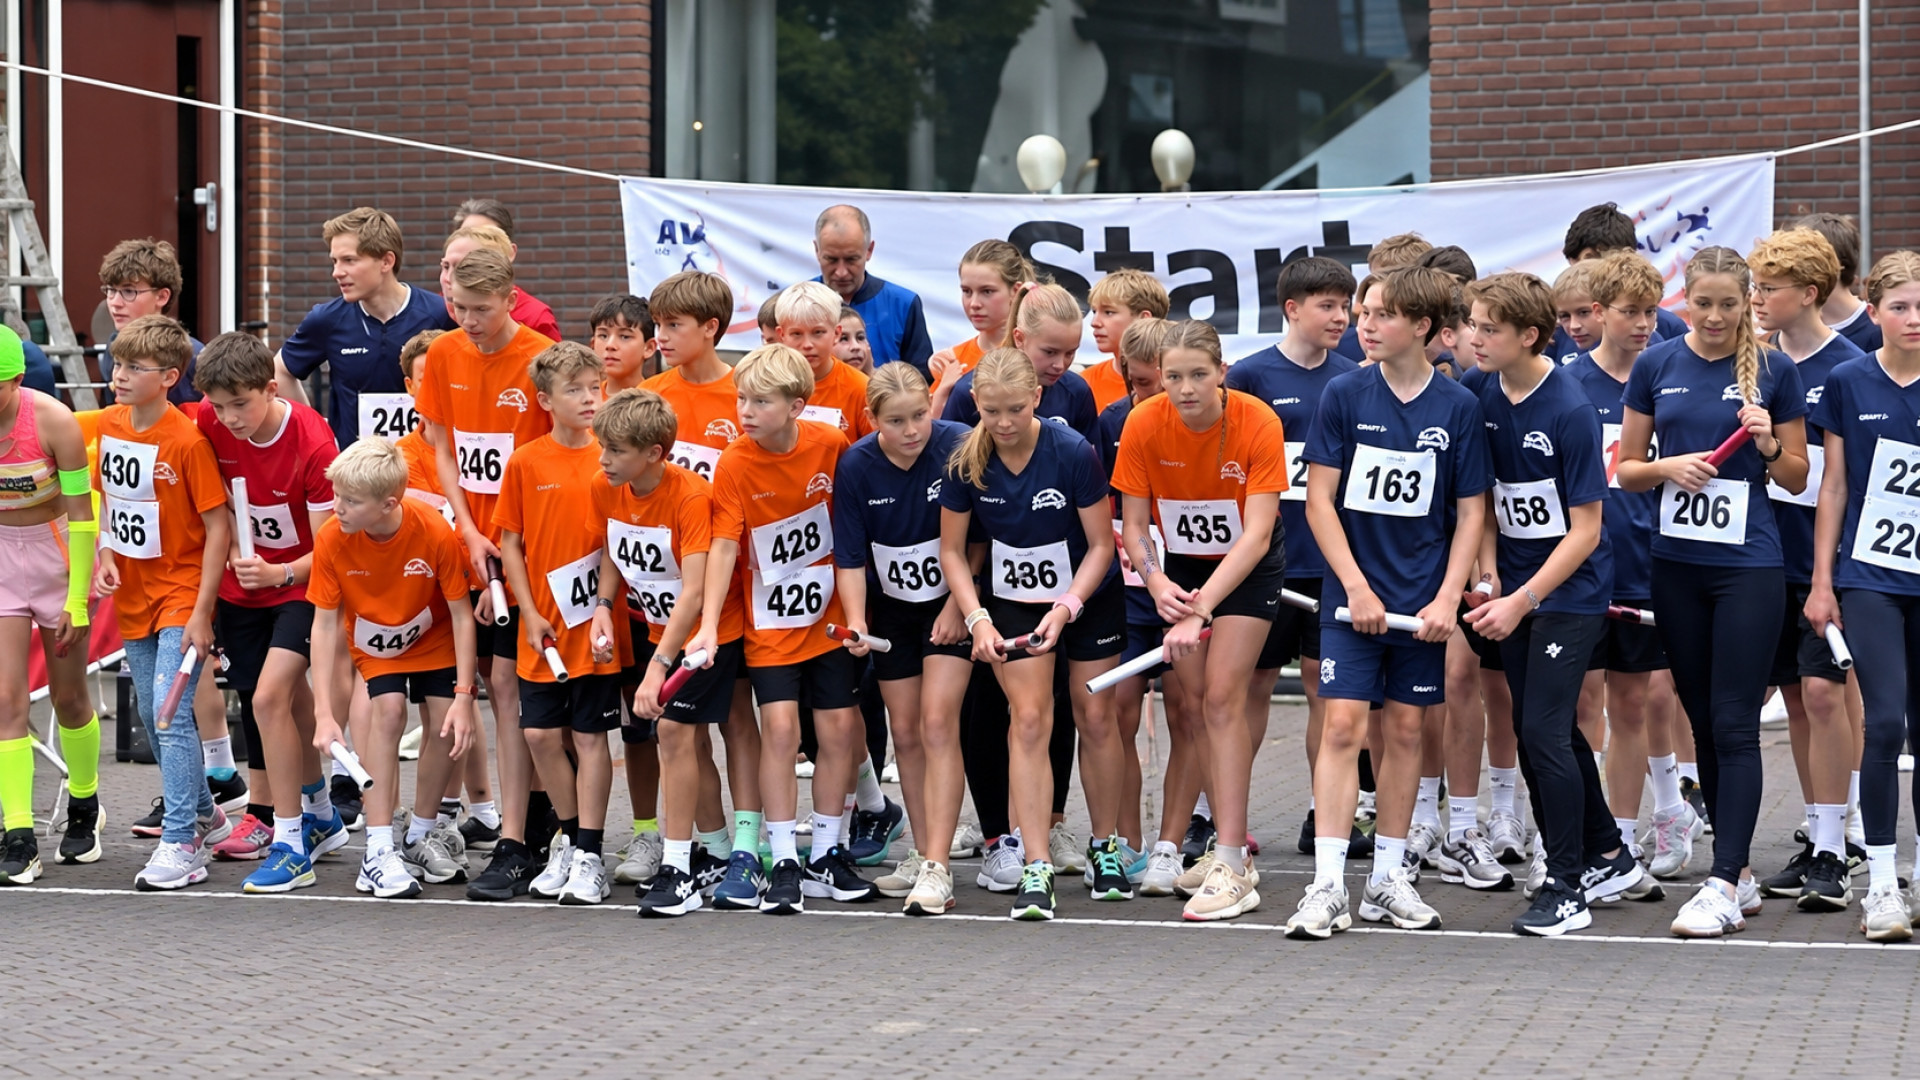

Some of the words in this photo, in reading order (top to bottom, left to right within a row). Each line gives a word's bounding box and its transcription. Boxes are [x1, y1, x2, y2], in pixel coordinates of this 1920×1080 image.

[372, 407, 419, 437] 246
[101, 452, 140, 489] 430
[459, 446, 502, 482] 246
[1291, 456, 1308, 487] 2
[1884, 458, 1920, 499] 22
[1366, 466, 1421, 503] 163
[111, 509, 146, 547] 436
[1501, 496, 1551, 527] 158
[1672, 491, 1731, 529] 206
[771, 521, 822, 565] 428
[1177, 514, 1232, 544] 435
[1870, 518, 1920, 561] 22
[617, 537, 666, 573] 442
[887, 556, 942, 590] 436
[571, 570, 600, 608] 44
[1003, 559, 1058, 589] 436
[767, 582, 822, 617] 426
[367, 624, 420, 652] 442
